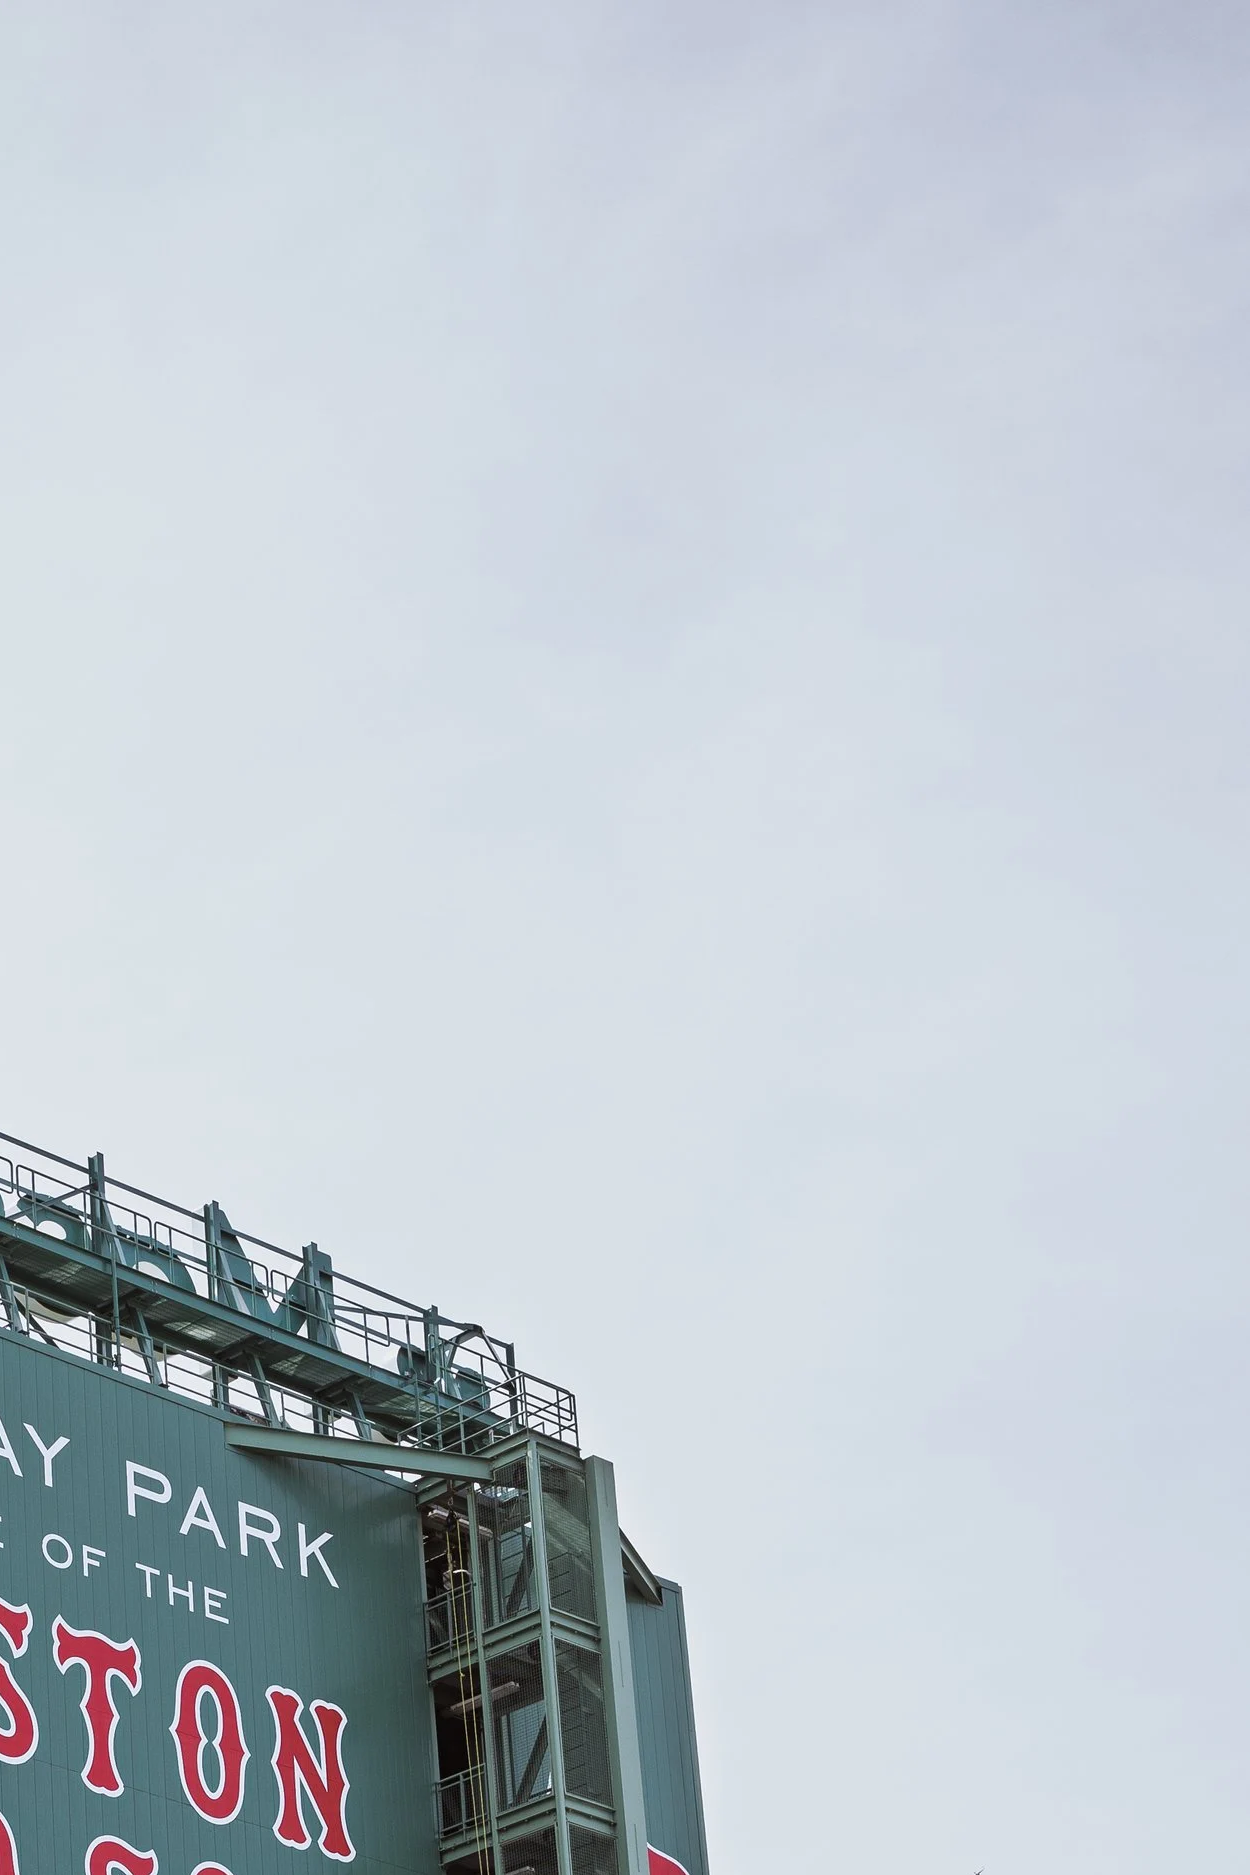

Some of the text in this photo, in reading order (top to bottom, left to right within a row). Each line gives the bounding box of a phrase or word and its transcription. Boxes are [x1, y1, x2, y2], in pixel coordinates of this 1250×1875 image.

[126, 1459, 340, 1588] PARK
[42, 1533, 107, 1577] OF
[136, 1562, 230, 1625] THE
